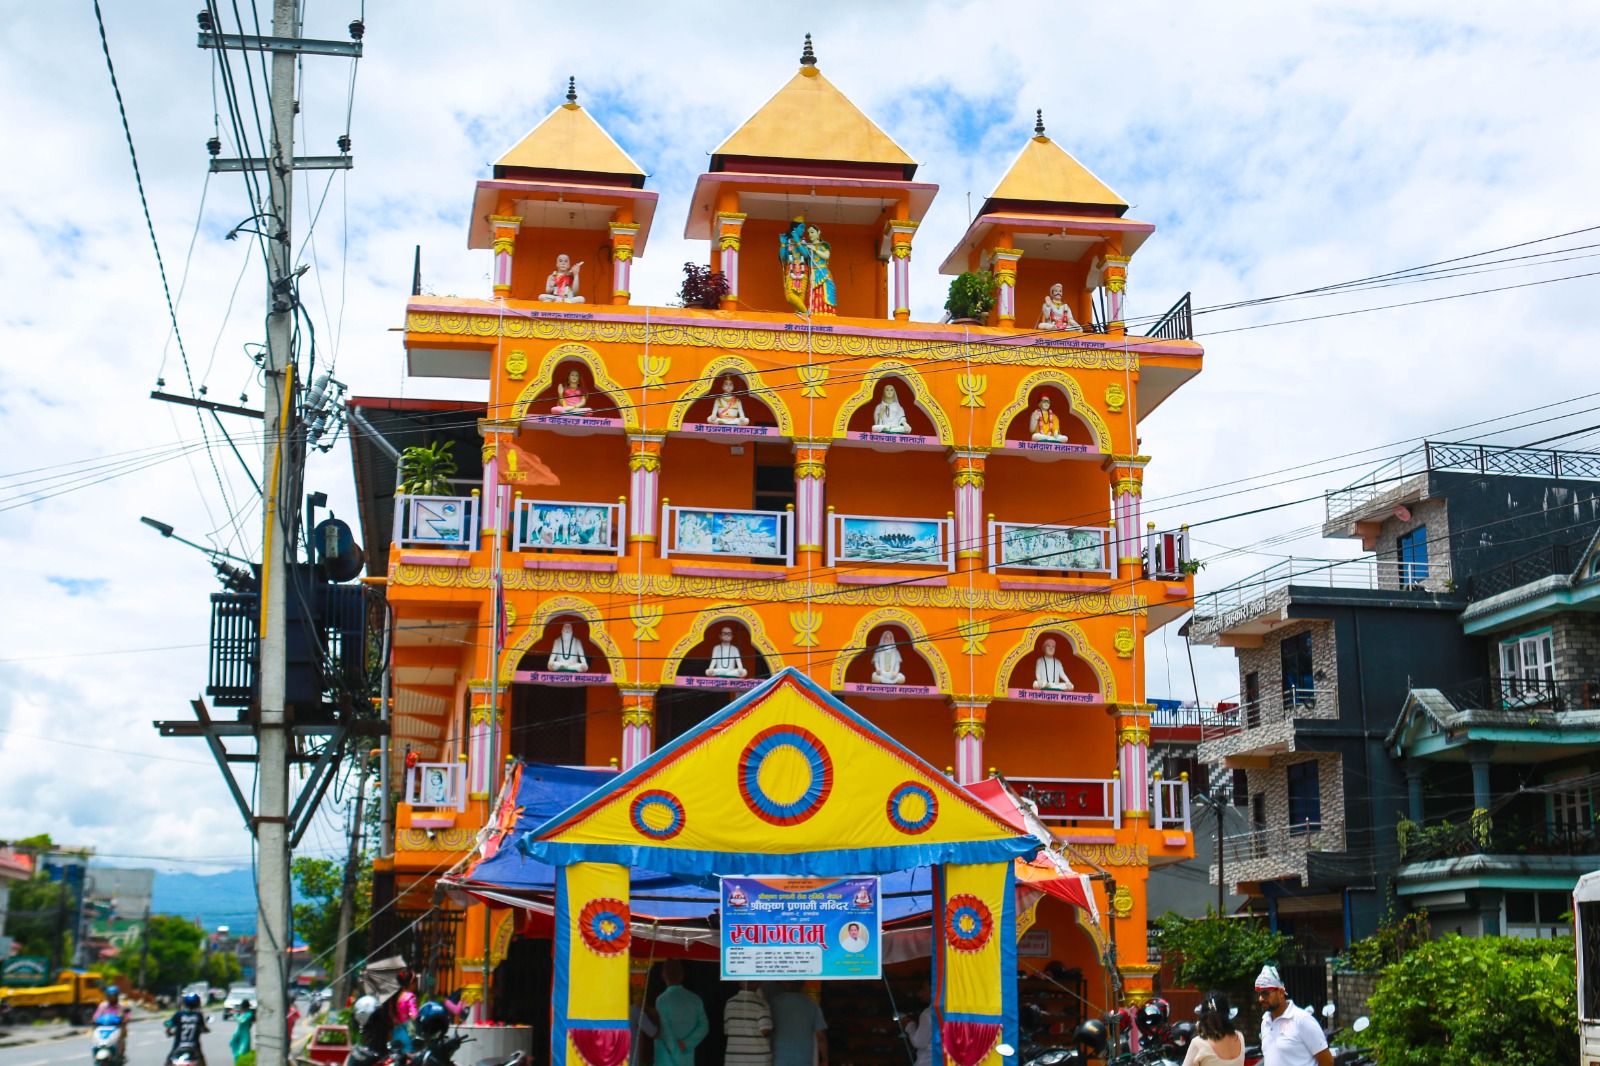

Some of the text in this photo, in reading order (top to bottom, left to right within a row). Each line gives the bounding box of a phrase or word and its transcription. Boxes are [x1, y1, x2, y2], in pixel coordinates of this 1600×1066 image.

[1055, 444, 1087, 452] महाराजजी
[530, 672, 538, 680] श्री
[686, 676, 694, 685] श्री
[1061, 693, 1094, 702] महाराजजी
[750, 900, 785, 912] श्रीकृष्ण
[788, 900, 817, 911] प्रणामी
[820, 899, 849, 910] मन्दिर
[730, 924, 829, 950] स्वागतम्
